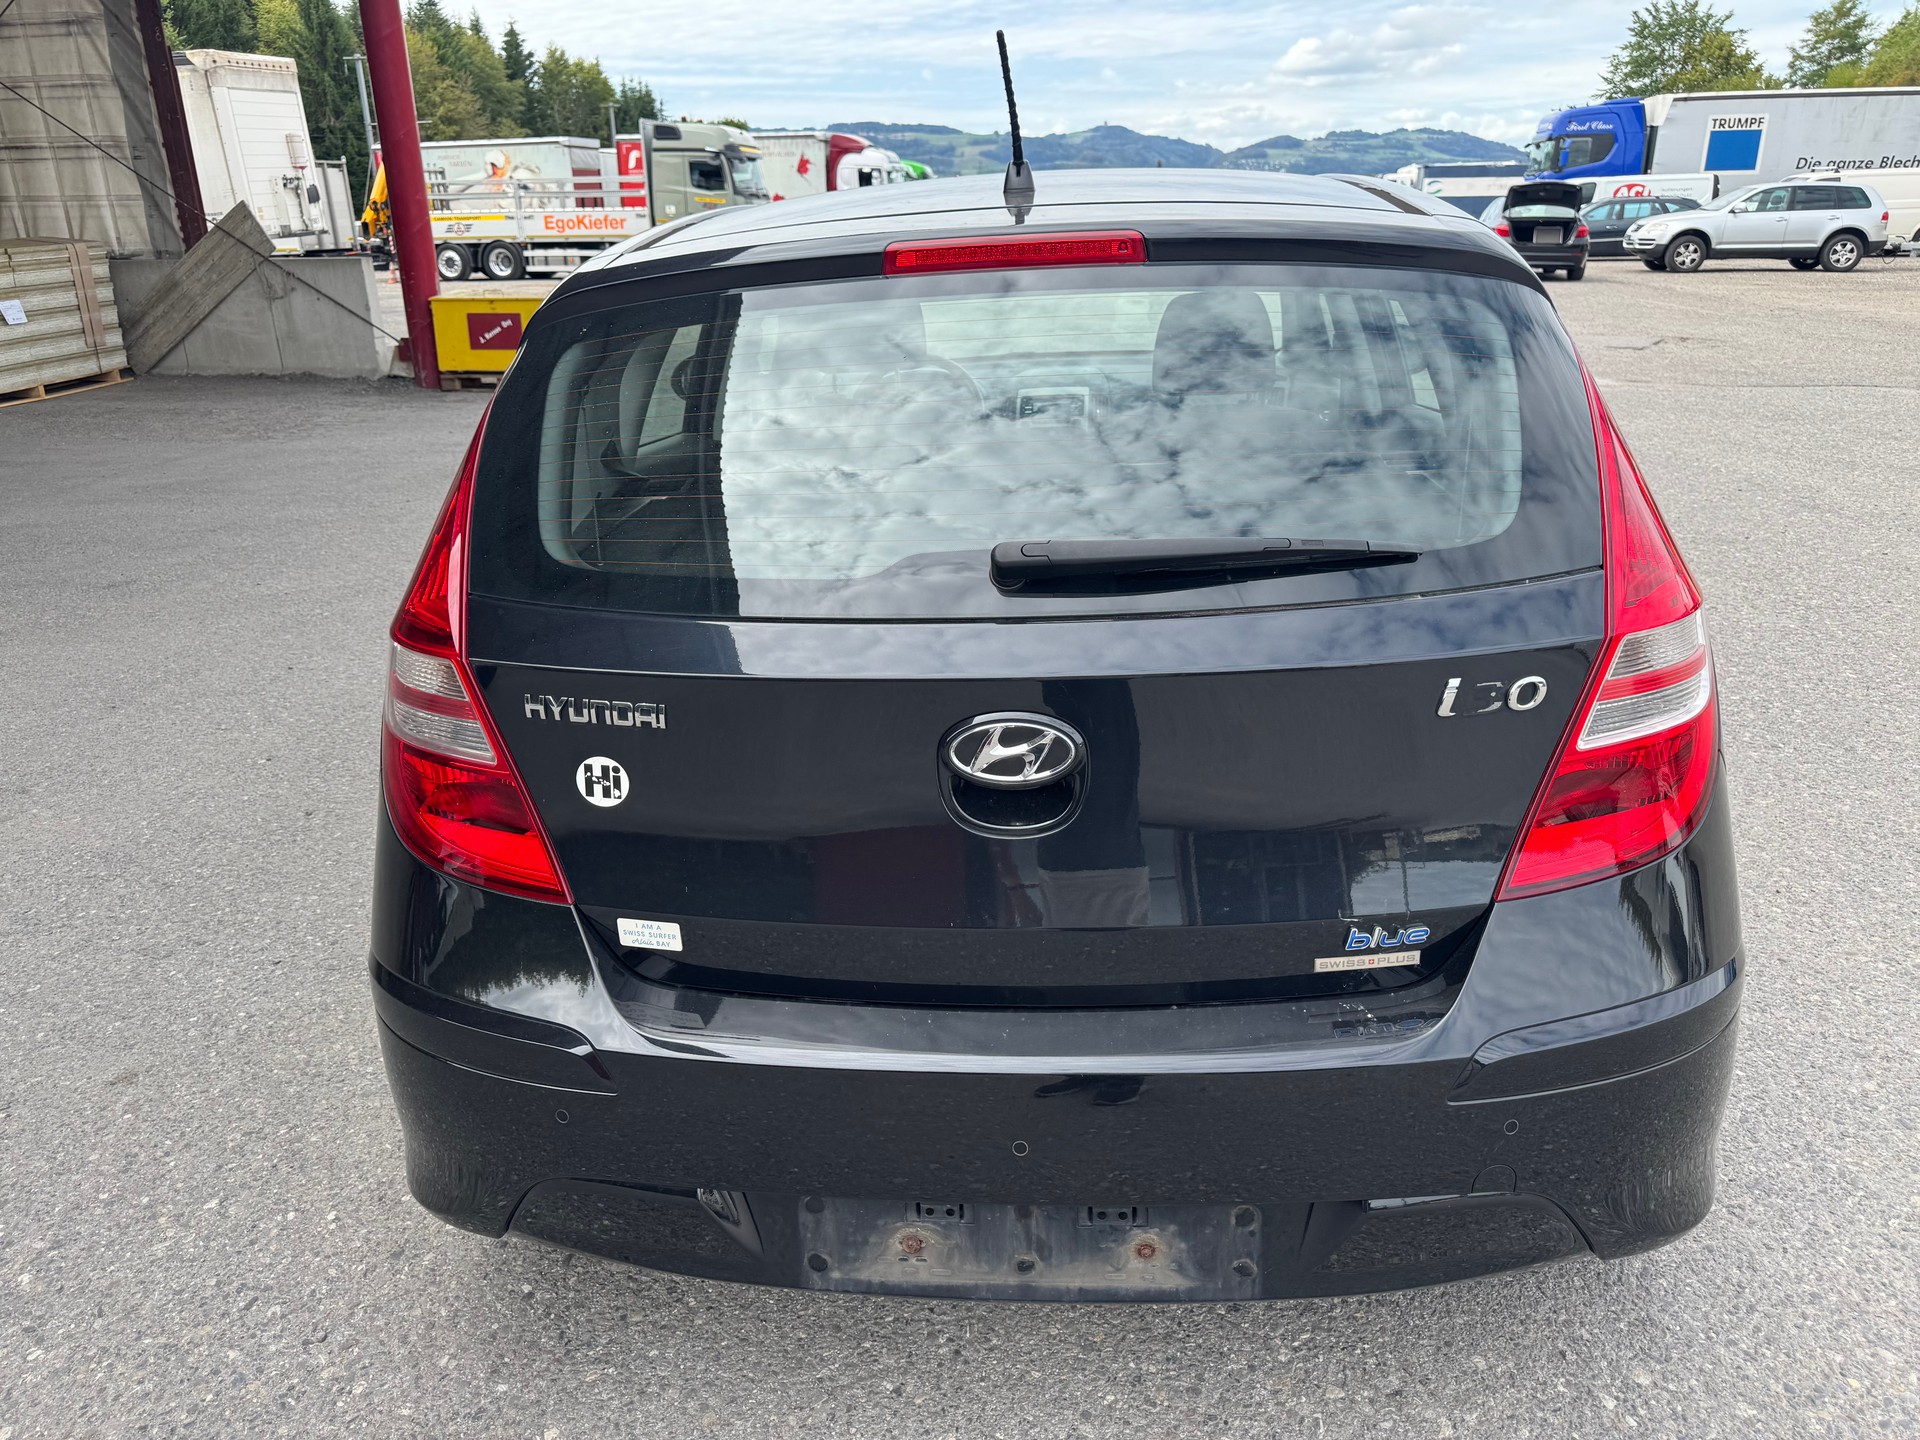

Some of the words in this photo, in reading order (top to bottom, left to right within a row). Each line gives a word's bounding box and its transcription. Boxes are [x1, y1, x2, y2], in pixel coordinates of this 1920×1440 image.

[1590, 121, 1614, 130] Class
[1711, 116, 1765, 129] TRUMPF
[1795, 156, 1821, 170] Die
[1826, 159, 1873, 171] ganze
[543, 214, 627, 234] EgoKiefer
[524, 693, 667, 729] HYUNDAI
[584, 763, 622, 800] Hi
[623, 929, 645, 937] SWISS
[648, 932, 677, 940] SURFER
[1345, 926, 1431, 951] blue
[1319, 959, 1366, 969] SWISS
[1377, 954, 1416, 965] PLUS
